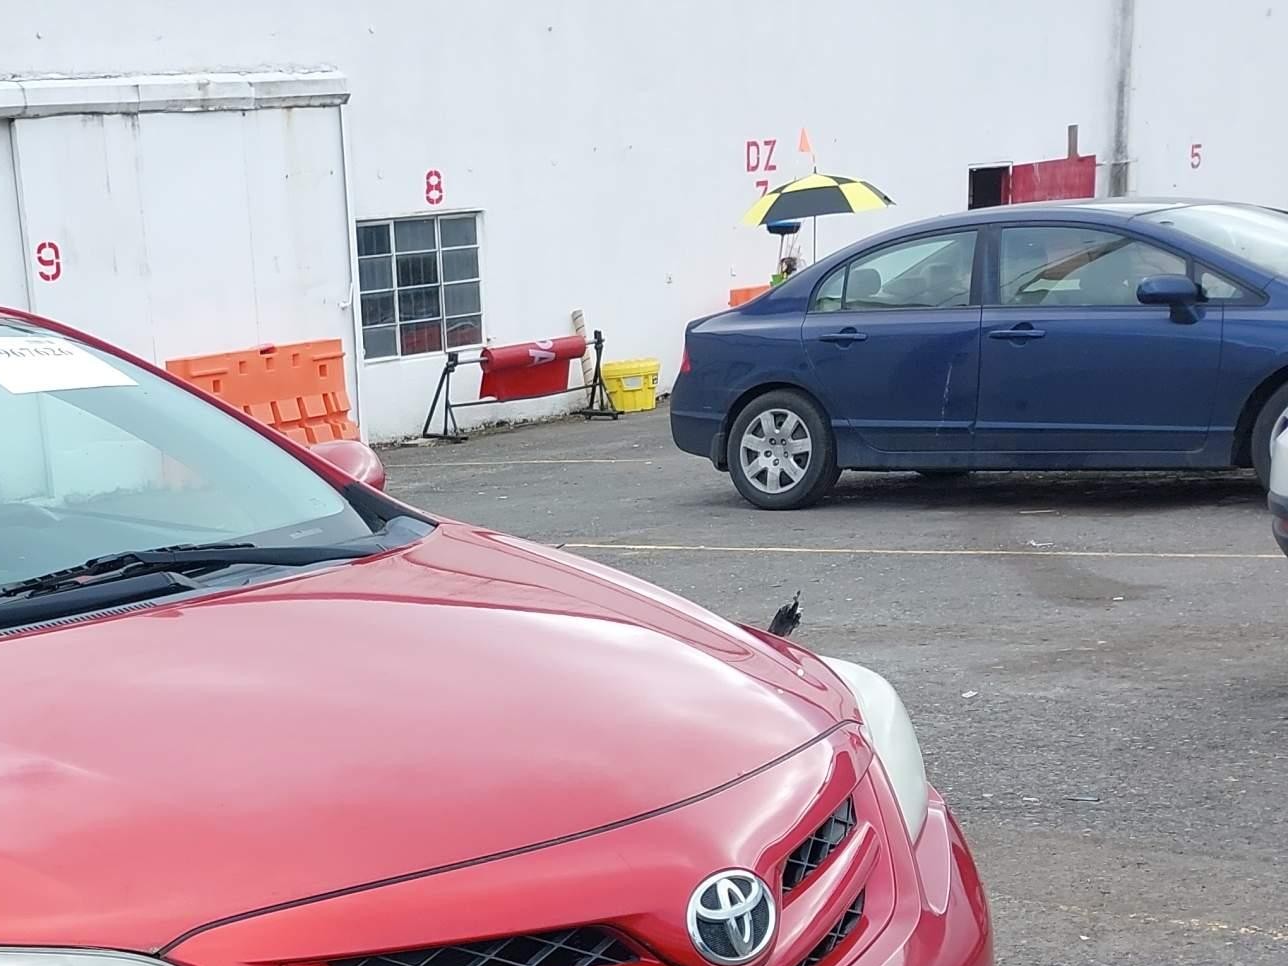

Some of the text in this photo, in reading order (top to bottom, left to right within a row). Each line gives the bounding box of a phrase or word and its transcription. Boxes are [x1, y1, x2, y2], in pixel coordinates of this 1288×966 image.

[746, 140, 777, 172] DZ
[1191, 143, 1202, 169] 5
[426, 170, 443, 205] 8
[37, 242, 61, 281] 9
